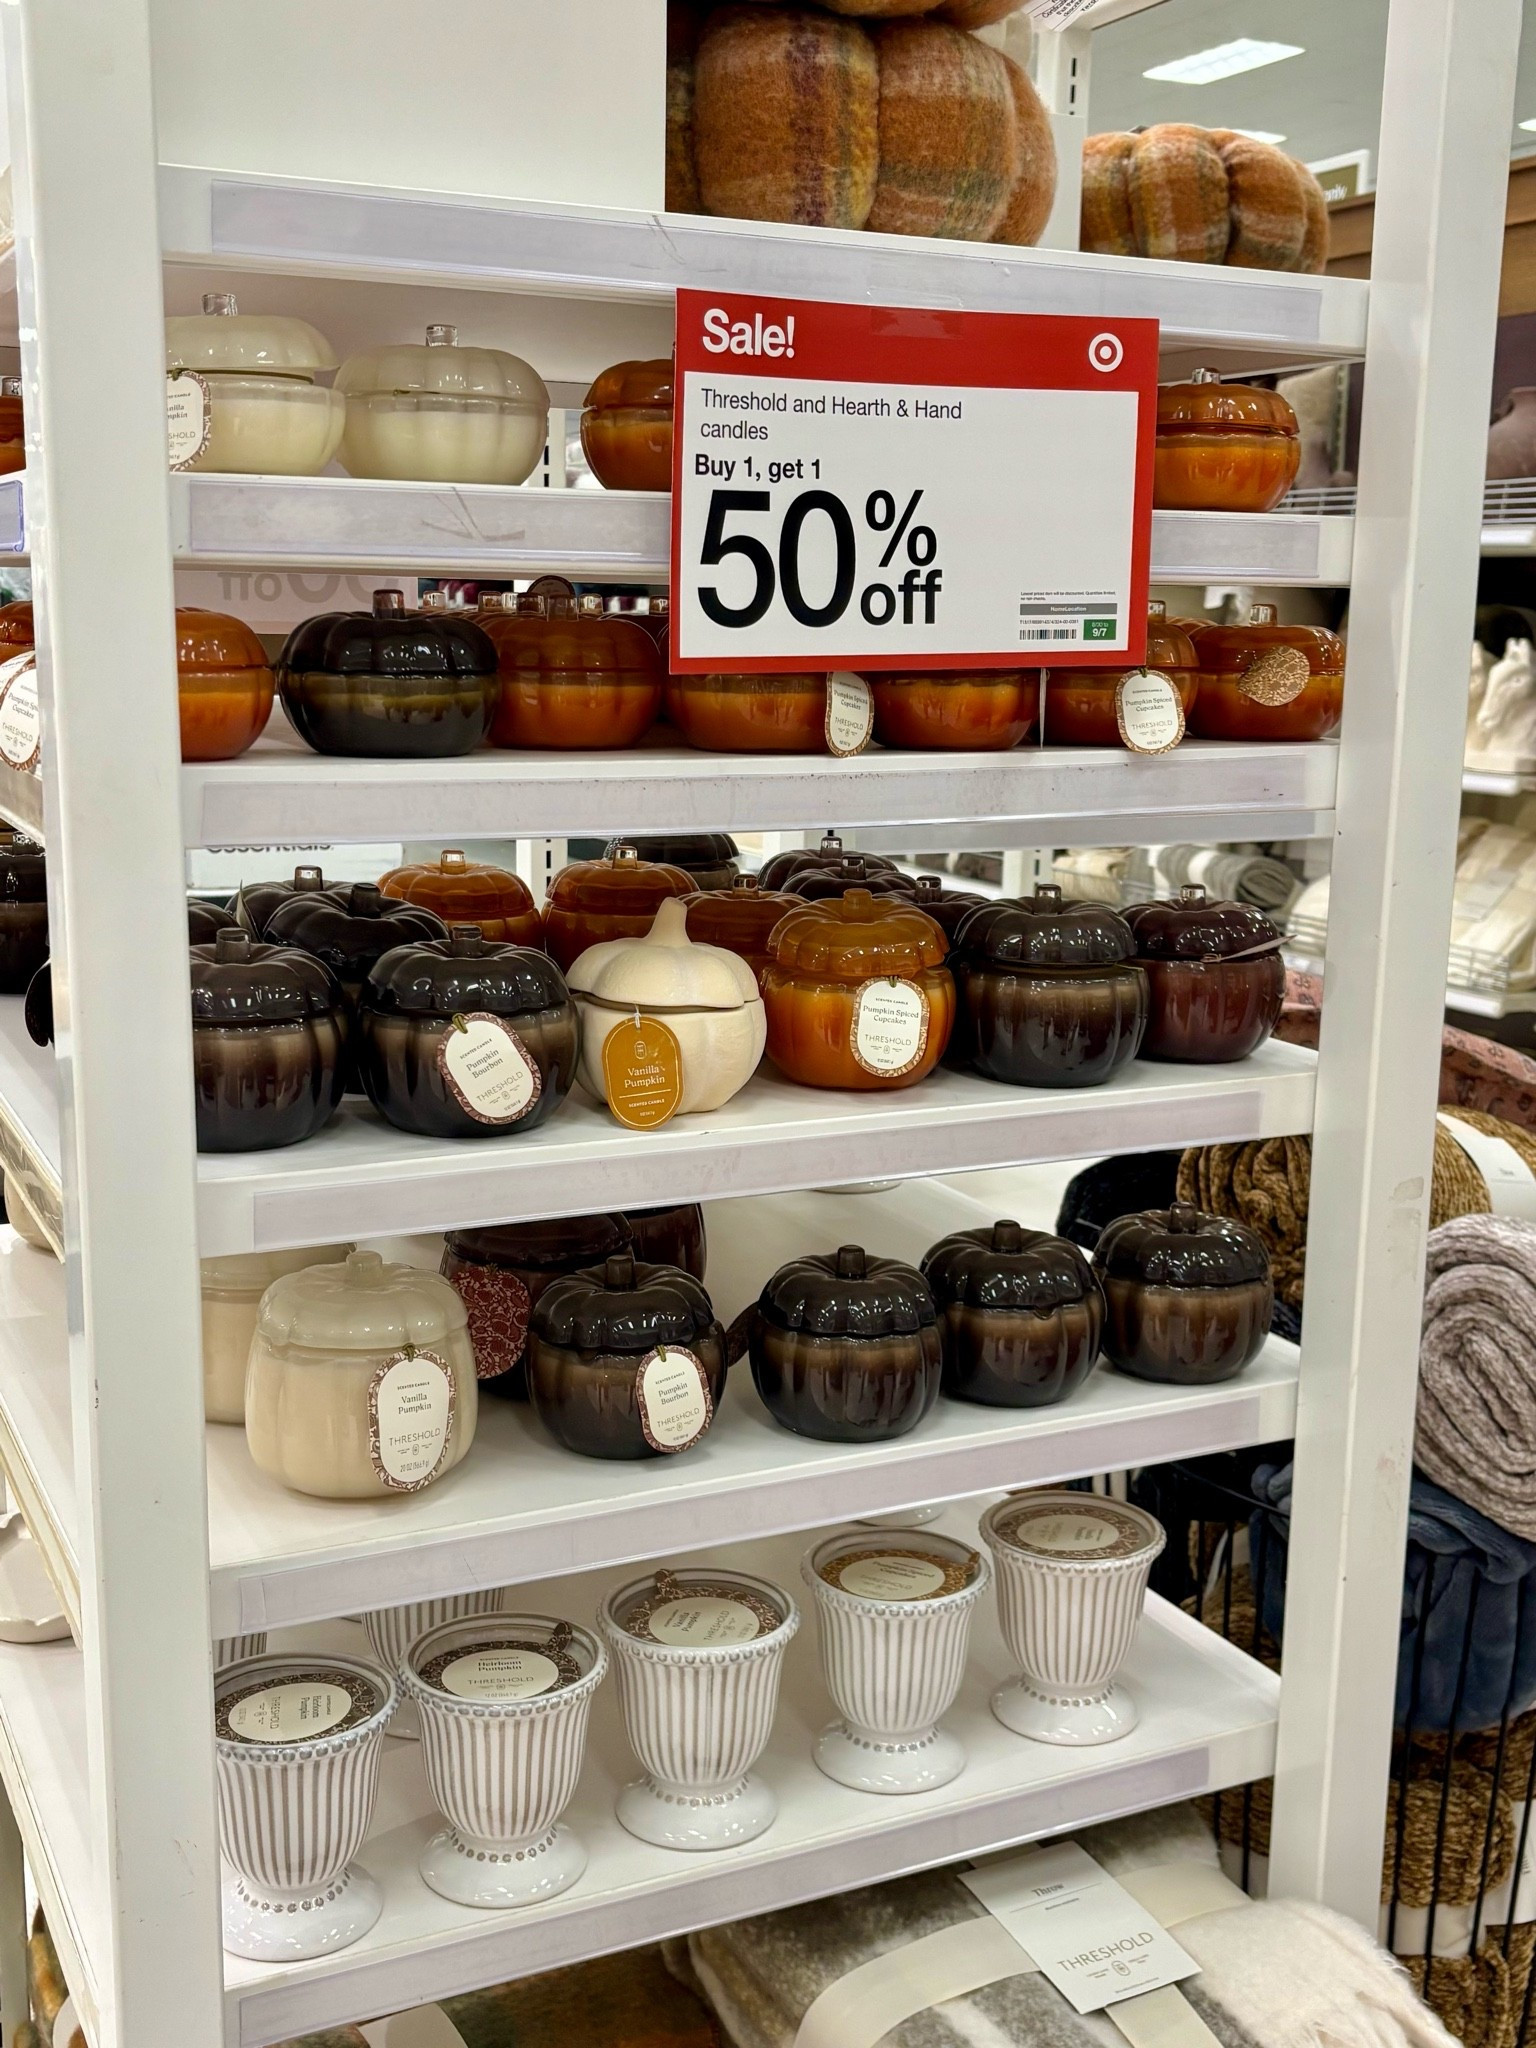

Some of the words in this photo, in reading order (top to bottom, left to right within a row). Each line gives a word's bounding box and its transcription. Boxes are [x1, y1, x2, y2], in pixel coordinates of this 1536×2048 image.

[702, 308, 795, 359] Sale!
[701, 388, 787, 412] Threshold
[793, 396, 826, 414] and
[832, 396, 890, 417] Hearth
[896, 400, 910, 418] &
[915, 400, 962, 419] Hand
[168, 431, 196, 440] SHOLD
[700, 420, 769, 440] candles
[695, 453, 737, 481] Buy
[743, 456, 761, 481] 1,
[768, 459, 804, 483] get
[811, 458, 821, 480] 1
[860, 568, 943, 626] off
[1092, 628, 1107, 637] 9/7
[1136, 704, 1164, 712] Cupcakes
[835, 716, 864, 730] THRESHOLD
[1131, 720, 1173, 730] THRESHOLD
[863, 1005, 894, 1015] Pumpkin
[896, 1010, 919, 1018] Spiced
[874, 1014, 906, 1025] Cupcakes
[865, 1034, 912, 1046] THRESHOLD
[466, 1049, 500, 1072] Pumpkin
[472, 1057, 504, 1079] Bourbon
[628, 1064, 660, 1076] Vanilla
[476, 1071, 524, 1102] THRESHOLD
[624, 1076, 666, 1088] Pumpkin
[658, 1382, 688, 1398] Pumpkin
[401, 1393, 428, 1404] Vanilla
[660, 1391, 689, 1405] Bourbon
[398, 1402, 432, 1415] Pumpkin
[657, 1407, 700, 1428] THRESHOLD
[389, 1428, 440, 1447] THRESHOLD
[703, 1610, 730, 1640] THRESHOLD
[468, 1676, 534, 1685] THRESHOLD
[270, 1696, 281, 1730] THRESHOLD
[1032, 1882, 1064, 1897] Throw
[1056, 1931, 1154, 1973] THRESHOLD
